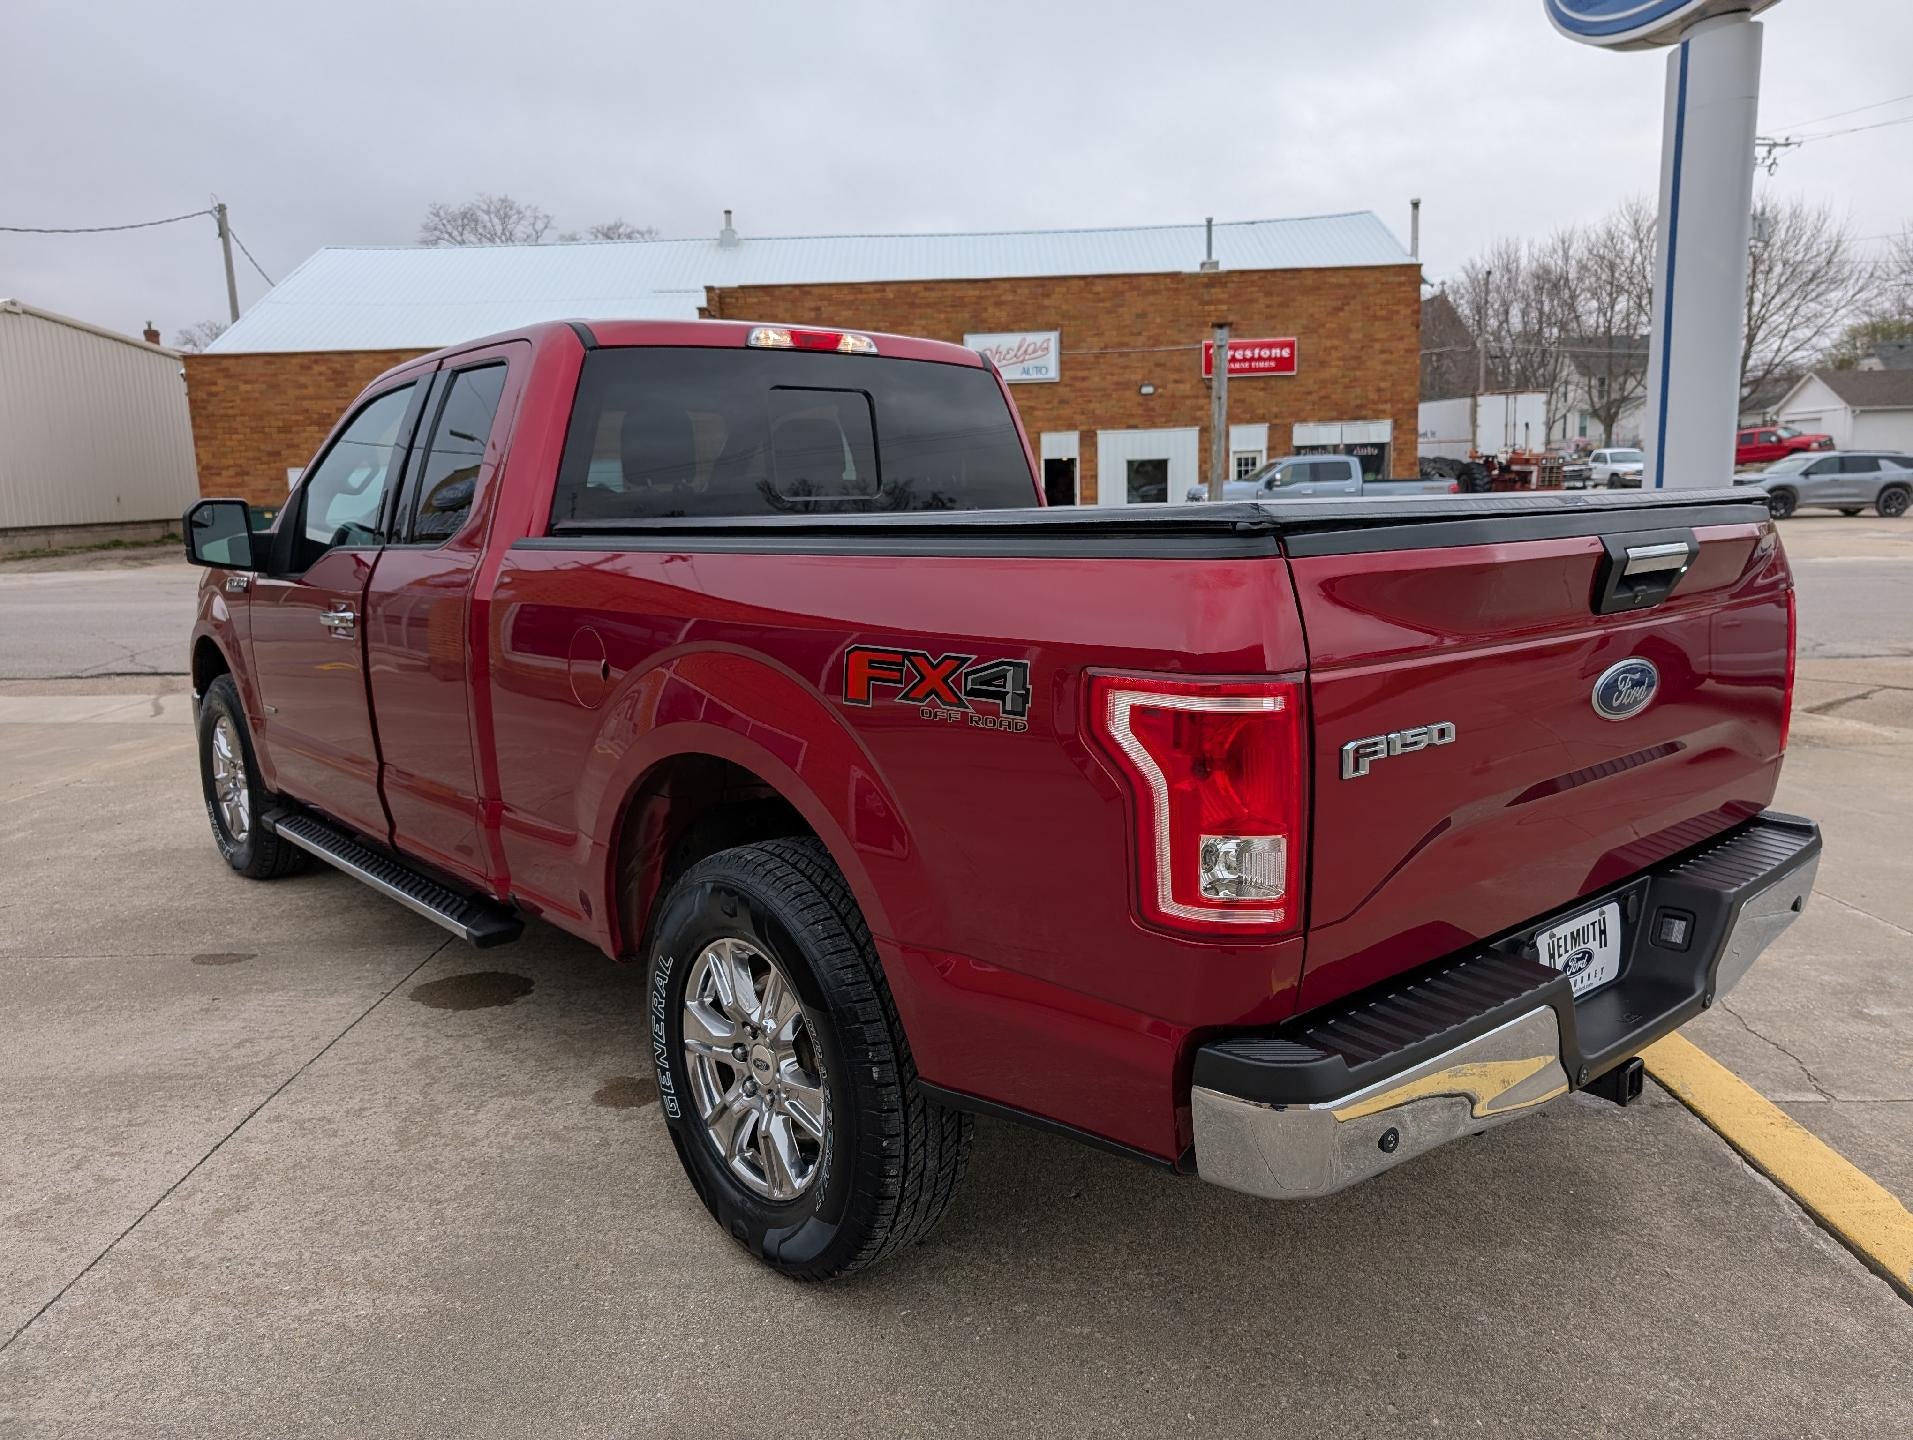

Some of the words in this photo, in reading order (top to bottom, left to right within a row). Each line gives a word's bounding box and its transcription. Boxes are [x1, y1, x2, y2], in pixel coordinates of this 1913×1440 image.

[1021, 366, 1048, 376] AUTO
[1209, 347, 1291, 359] restone
[843, 644, 1032, 720] FX4
[920, 706, 961, 723] OFF
[968, 712, 1028, 733] ROAD
[1547, 916, 1608, 969] HELMUTH
[651, 954, 681, 1119] GENERAL
